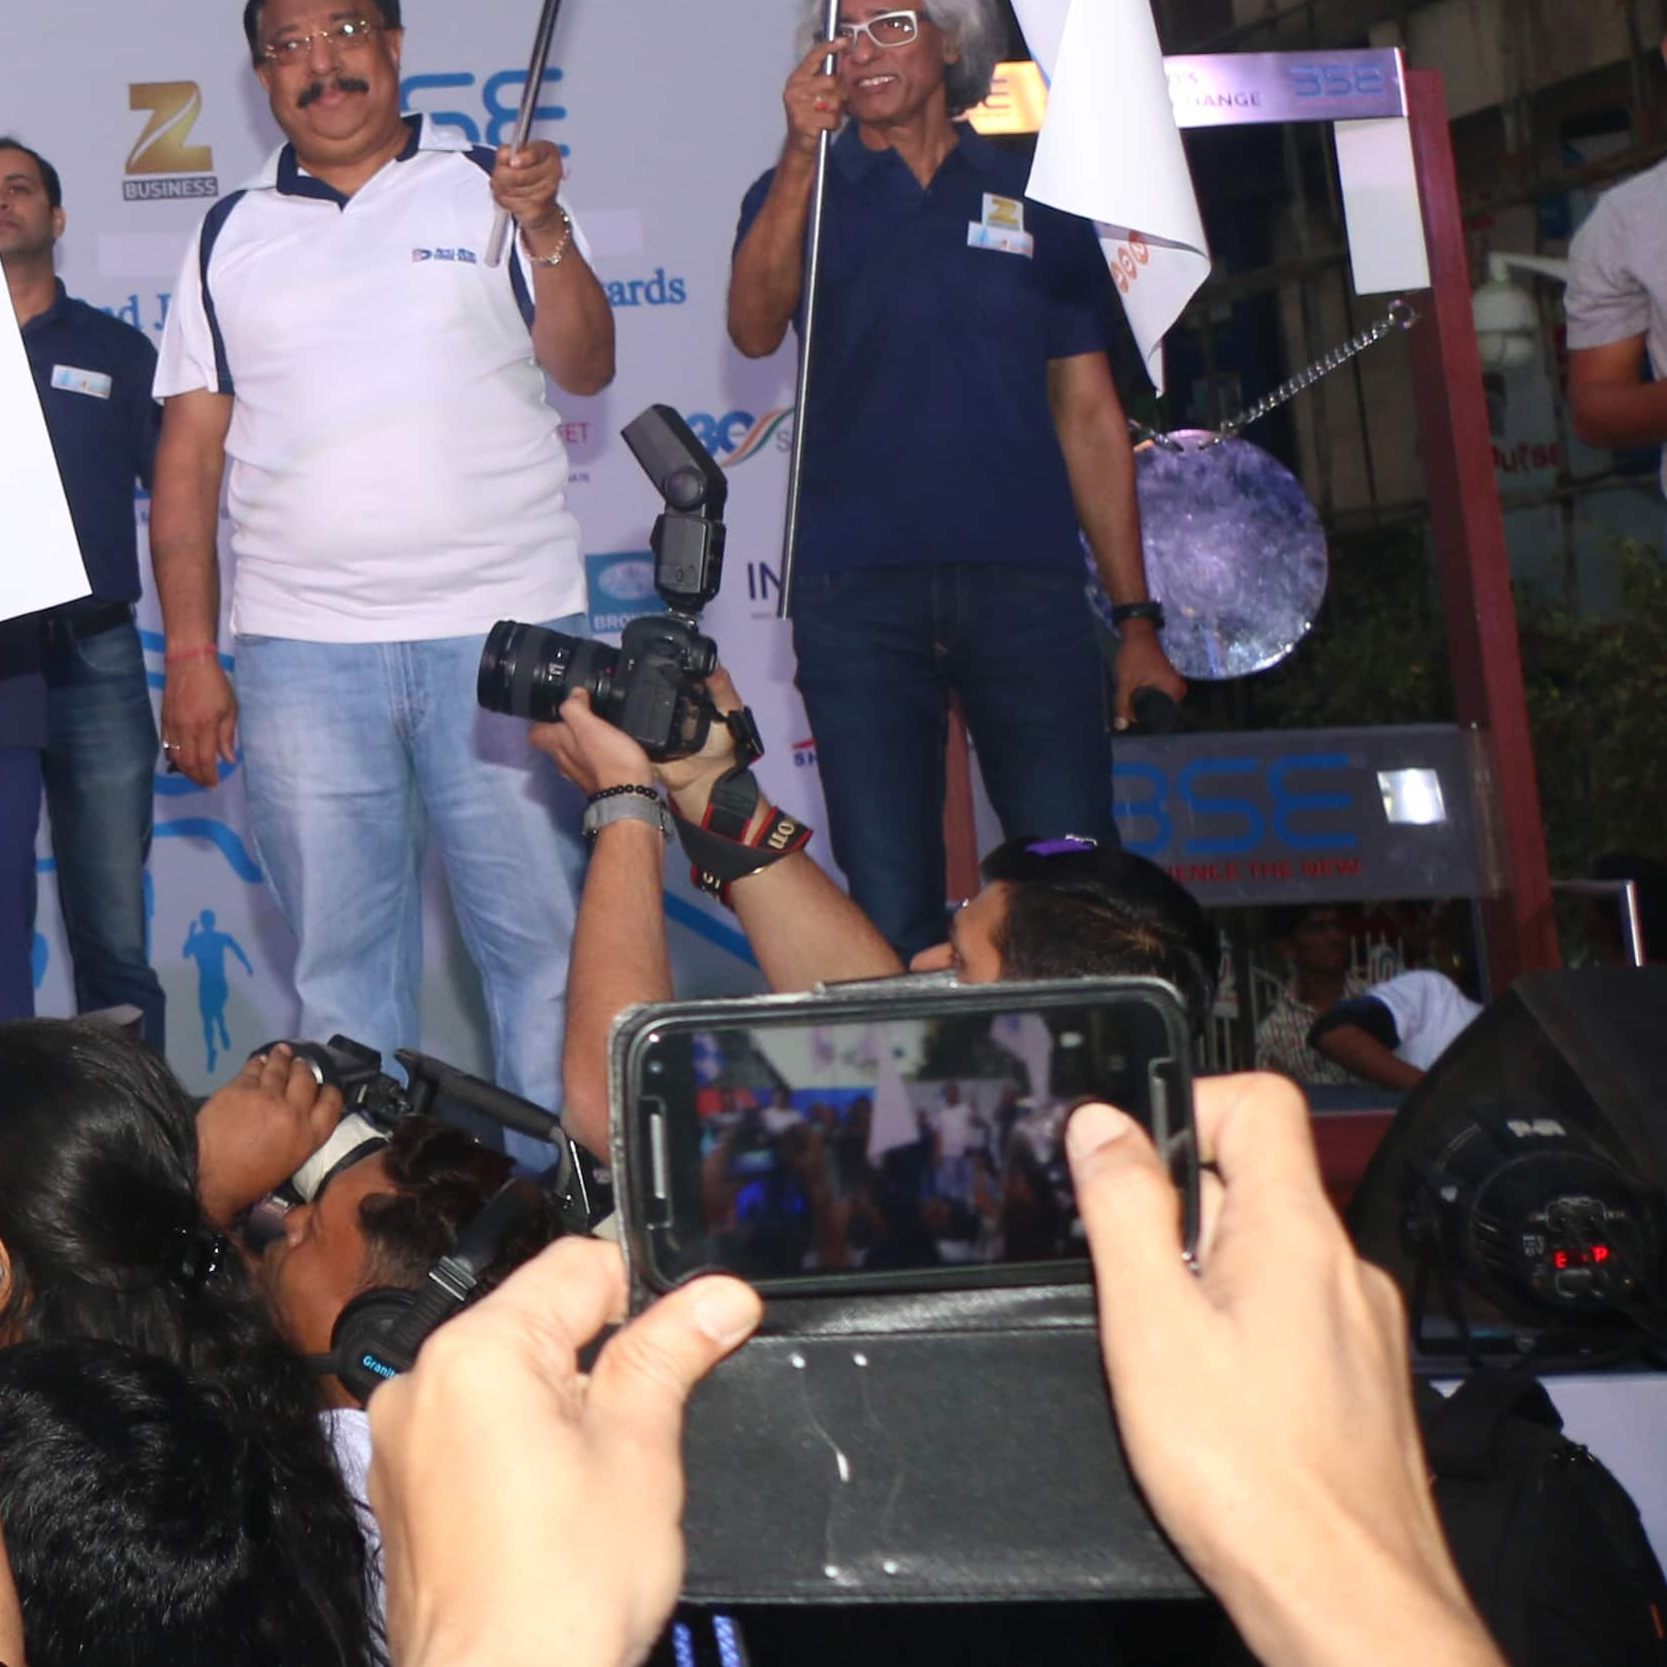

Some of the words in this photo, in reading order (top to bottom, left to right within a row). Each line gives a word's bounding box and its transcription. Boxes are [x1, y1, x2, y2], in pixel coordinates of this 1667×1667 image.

[400, 67, 571, 158] SE
[124, 180, 217, 199] BUSINESS
[603, 267, 687, 308] ards
[1114, 752, 1360, 857] BSE
[1248, 859, 1293, 880] THE
[1301, 856, 1362, 879] NEW
